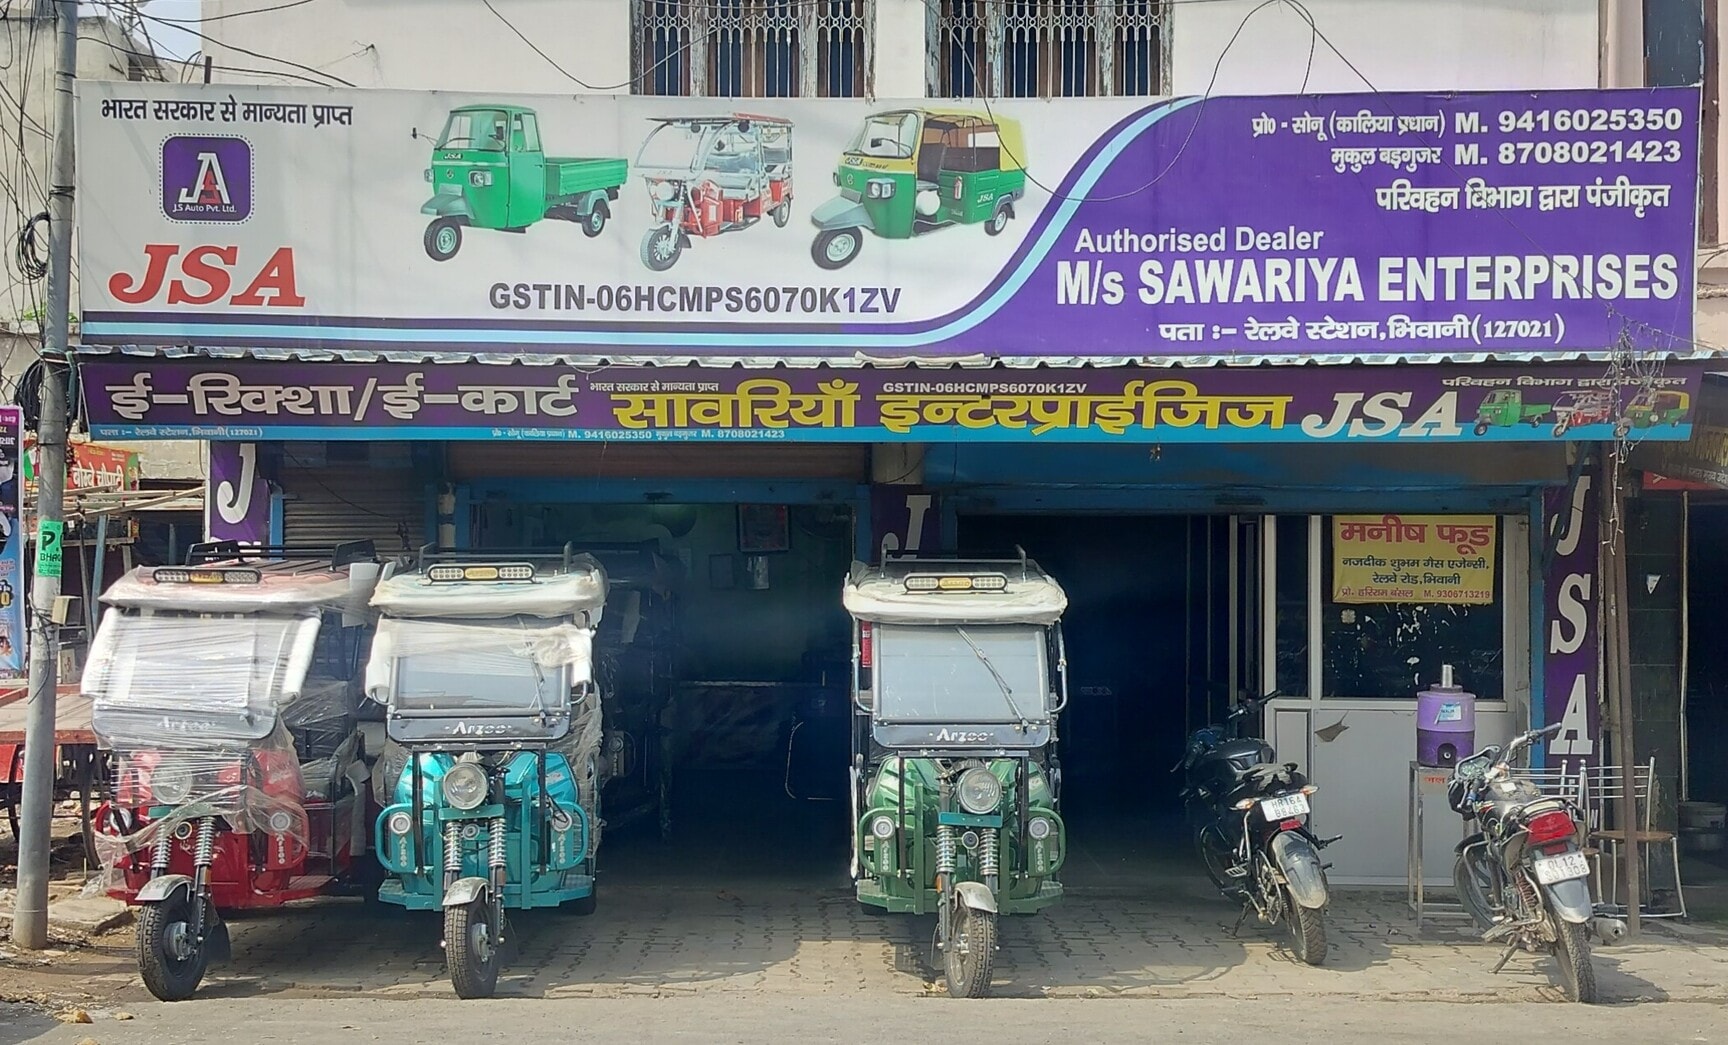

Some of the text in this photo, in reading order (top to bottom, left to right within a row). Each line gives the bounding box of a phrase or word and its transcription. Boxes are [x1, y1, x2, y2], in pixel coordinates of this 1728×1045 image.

[101, 95, 353, 128] भारत सरकार से मान्यता प्राप्त
[1292, 110, 1328, 141] सोनू
[1329, 109, 1393, 139] (कालिया
[1397, 109, 1446, 138] प्रधान)
[1455, 111, 1489, 134] M.
[1498, 108, 1682, 133] 9416025350
[1331, 147, 1377, 173] मुकुल
[1454, 143, 1488, 165] M.
[1497, 140, 1682, 165] 8708021423
[185, 204, 205, 212] Auto
[1375, 175, 1671, 218] परिवहन विभाग द्वारा पंजीकृत
[1074, 226, 1324, 253] Authorised Dealer
[108, 243, 305, 308] JSA
[1056, 253, 1678, 305] M/s SAWARIYA ENTERPRISES
[488, 282, 902, 314] GSTIN-06HCMPS6070K1ZV
[1158, 323, 1205, 341] पता
[1244, 316, 1300, 340] रेलवे
[590, 380, 719, 393] भारत सरकार से मान्यता प्राप्त
[883, 382, 1087, 394] GSTIN-06HCMPS6070K1ZV
[610, 378, 861, 429] सावरियाँ
[1300, 391, 1463, 438] JSA
[568, 430, 581, 438] M.
[584, 429, 652, 439] 9416025350
[701, 429, 715, 438] M.
[717, 429, 785, 438] 8708021423
[217, 443, 256, 524] J
[1340, 514, 1493, 554] मनीष फूड
[1342, 555, 1387, 567] नजदीक
[1390, 559, 1420, 571] शुभम
[1372, 572, 1397, 584] रेलवे
[1423, 589, 1434, 598] M.
[1437, 590, 1491, 599] 9306713219
[452, 721, 507, 735] Arzoo
[936, 728, 989, 742] Arzoo
